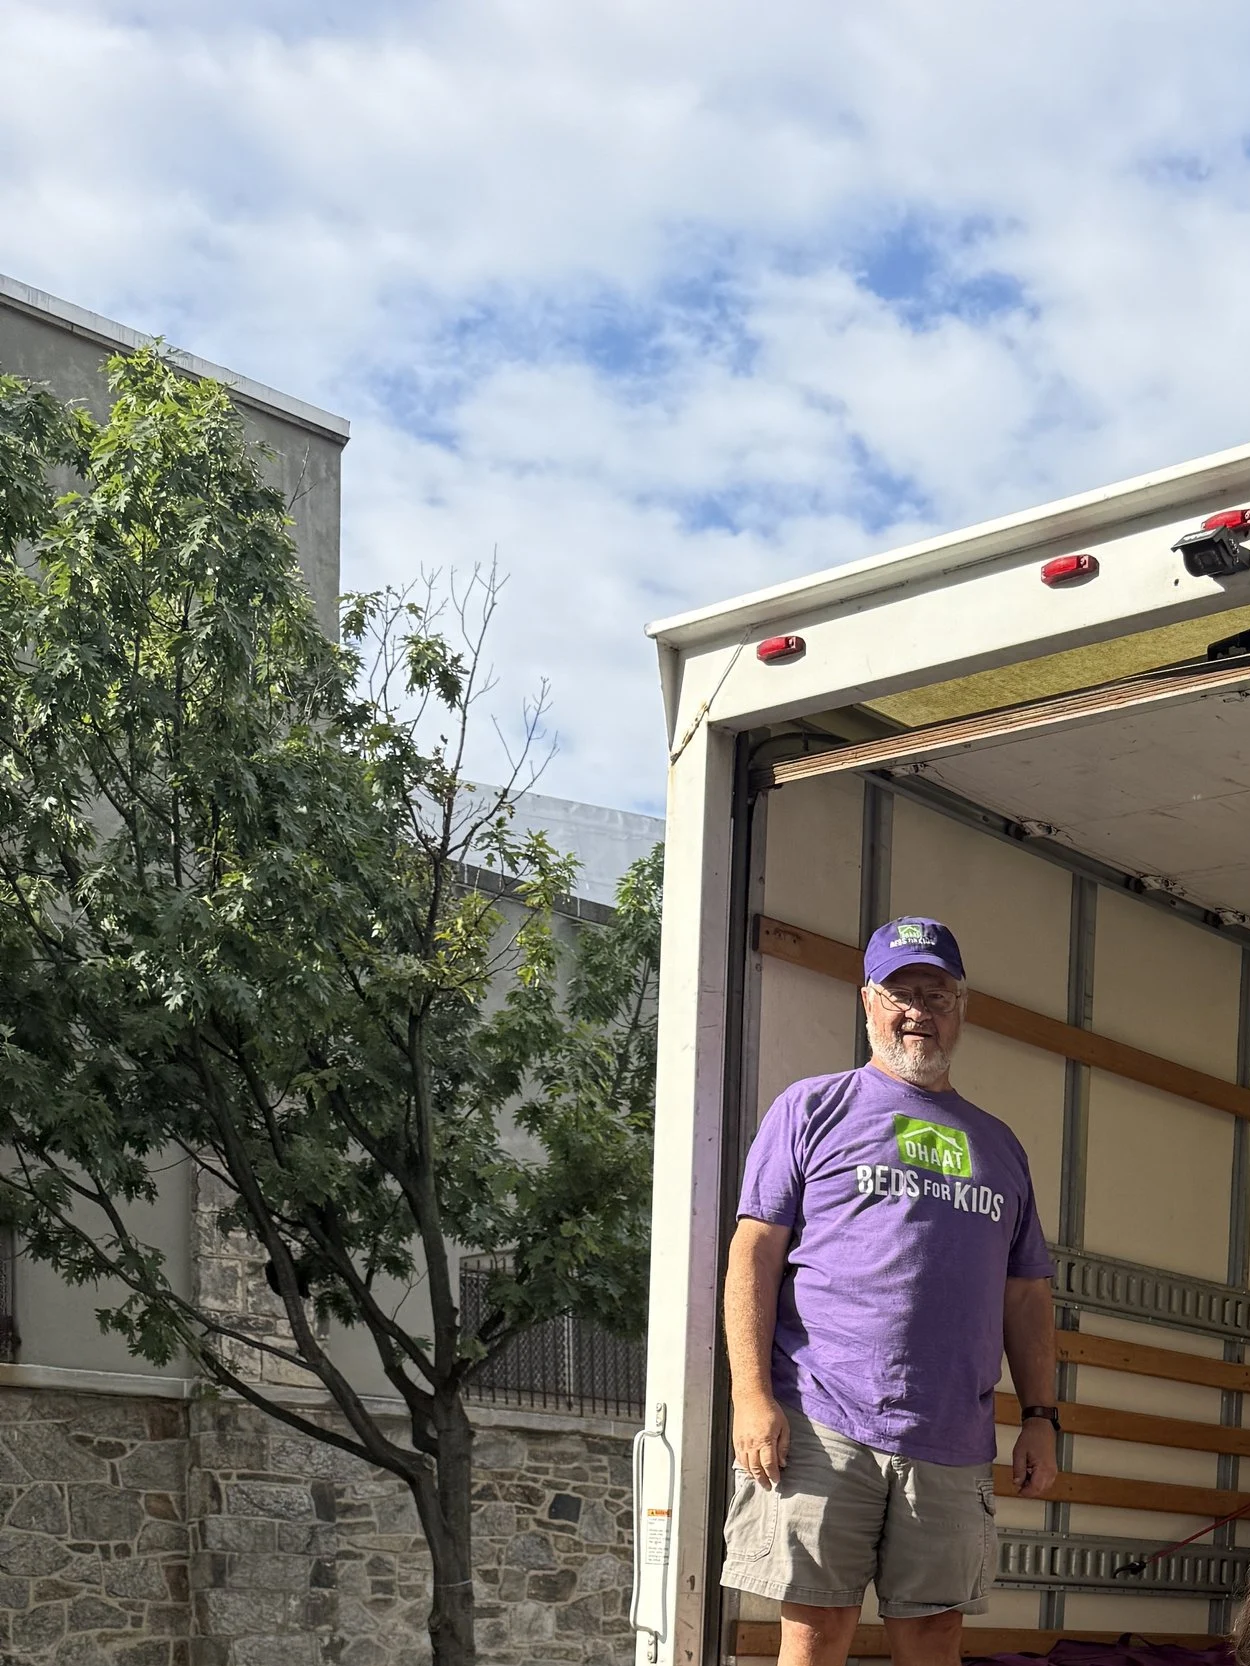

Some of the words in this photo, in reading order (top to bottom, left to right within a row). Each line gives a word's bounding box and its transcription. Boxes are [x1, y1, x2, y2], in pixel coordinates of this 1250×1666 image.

[904, 1140, 964, 1171] OHAAT
[855, 1164, 920, 1199] BEDS
[923, 1178, 951, 1201] FOR
[953, 1181, 1005, 1223] KIDS
